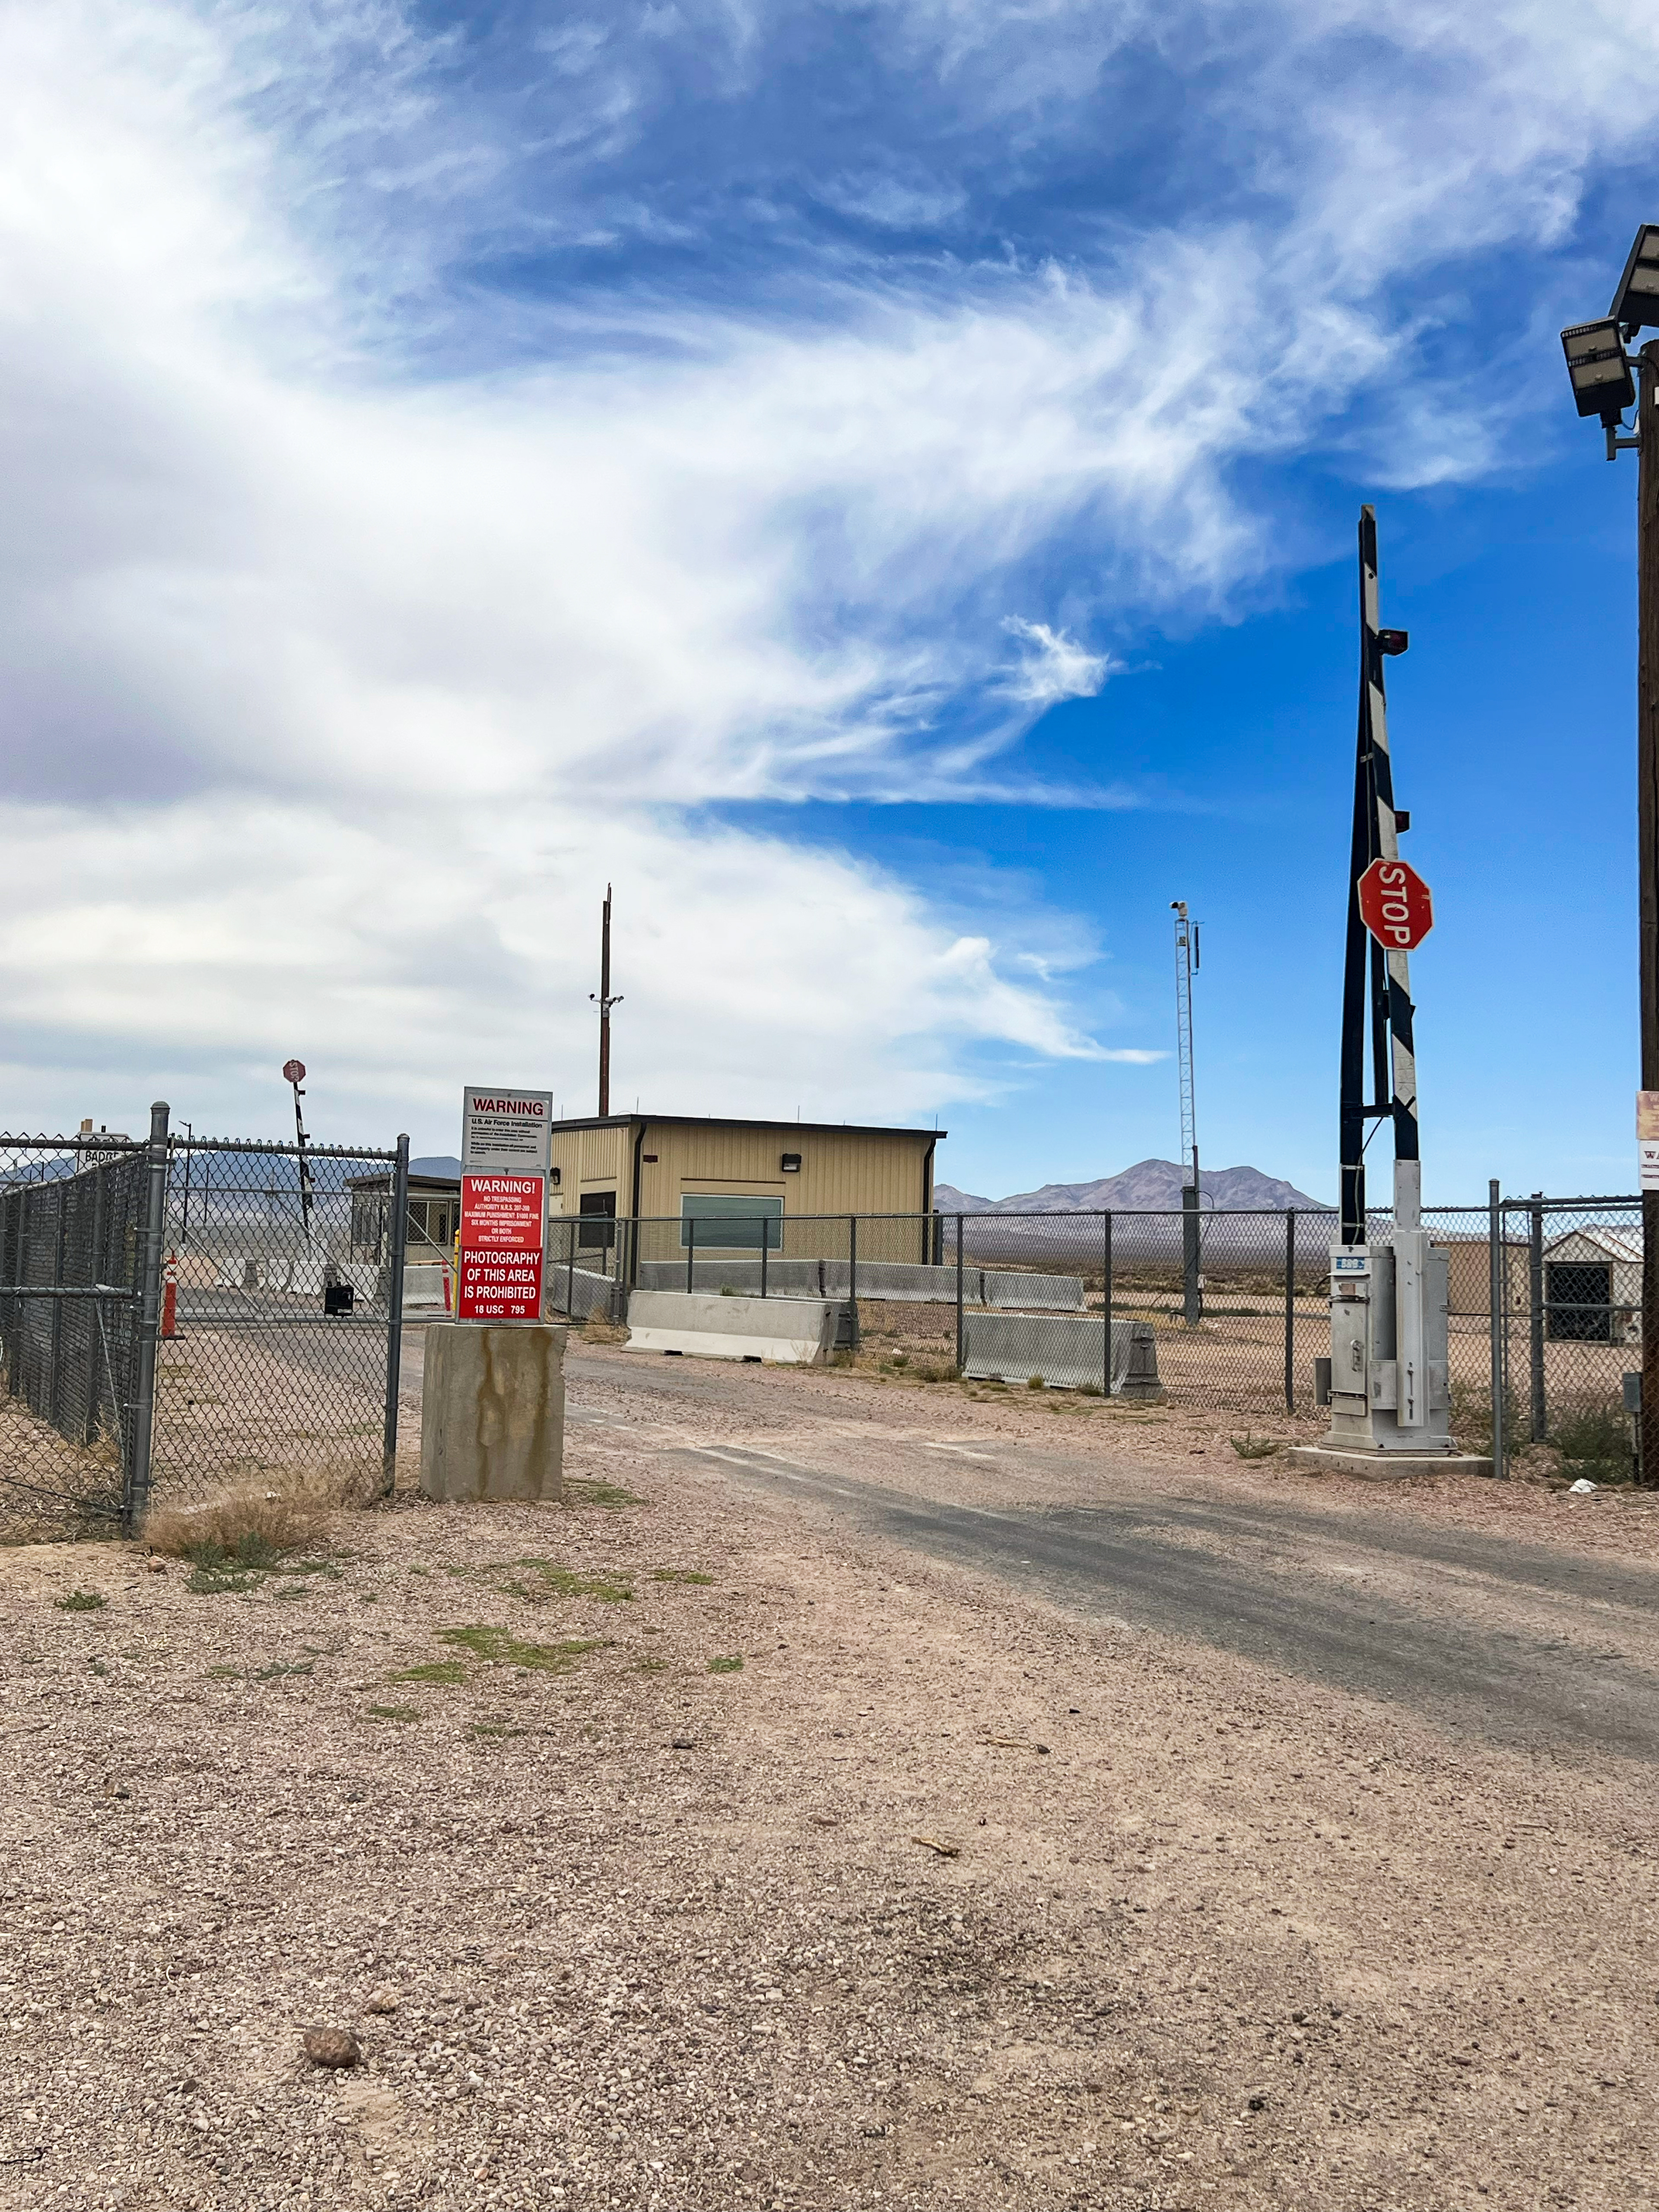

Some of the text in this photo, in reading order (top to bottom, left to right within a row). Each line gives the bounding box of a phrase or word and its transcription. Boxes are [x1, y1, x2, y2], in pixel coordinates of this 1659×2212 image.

[1378, 866, 1411, 944] STOP
[289, 1062, 299, 1081] STOP
[473, 1098, 543, 1116] WARNING
[470, 1179, 535, 1194] WARNING!
[464, 1251, 540, 1265] PHOTOGRAPHY
[467, 1268, 535, 1282] OF THIS AREA
[464, 1285, 536, 1299] IS PROHIBITED
[474, 1304, 525, 1314] 18 USC 795
